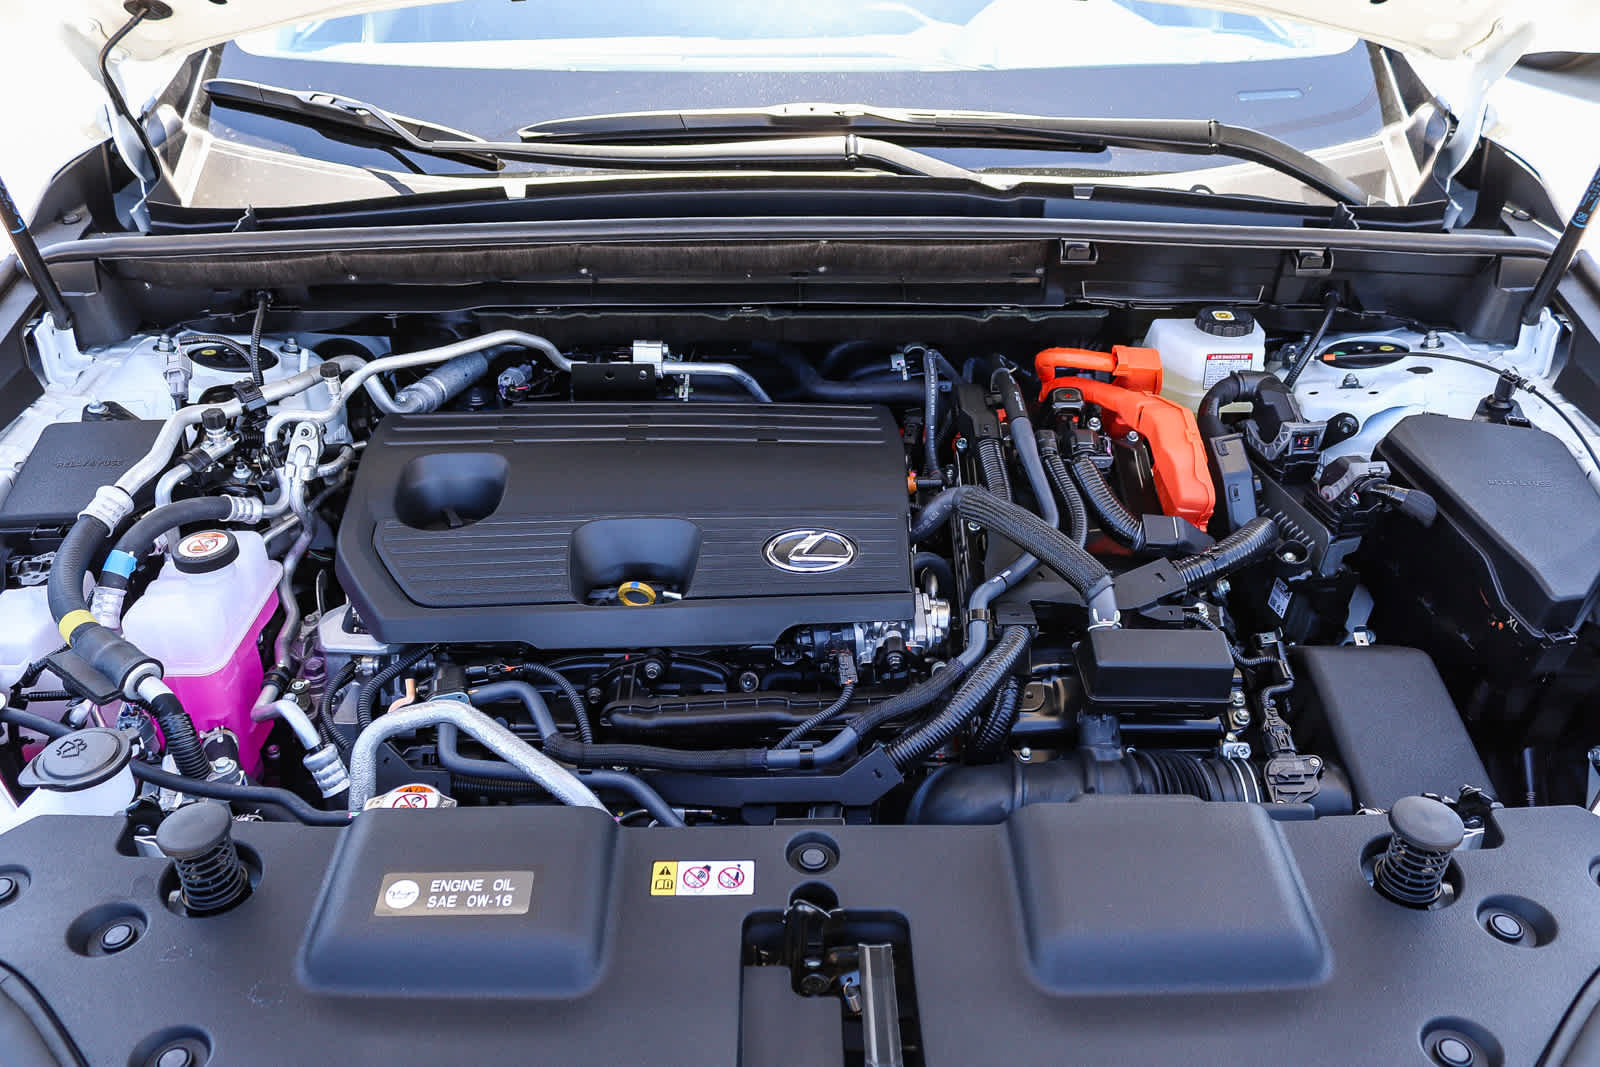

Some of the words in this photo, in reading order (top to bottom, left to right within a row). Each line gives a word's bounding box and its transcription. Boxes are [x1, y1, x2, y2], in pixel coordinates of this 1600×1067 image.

[430, 879, 485, 893] ENGINE
[493, 878, 515, 892] OIL
[426, 894, 458, 908] SAE
[466, 893, 513, 908] 0W-16
